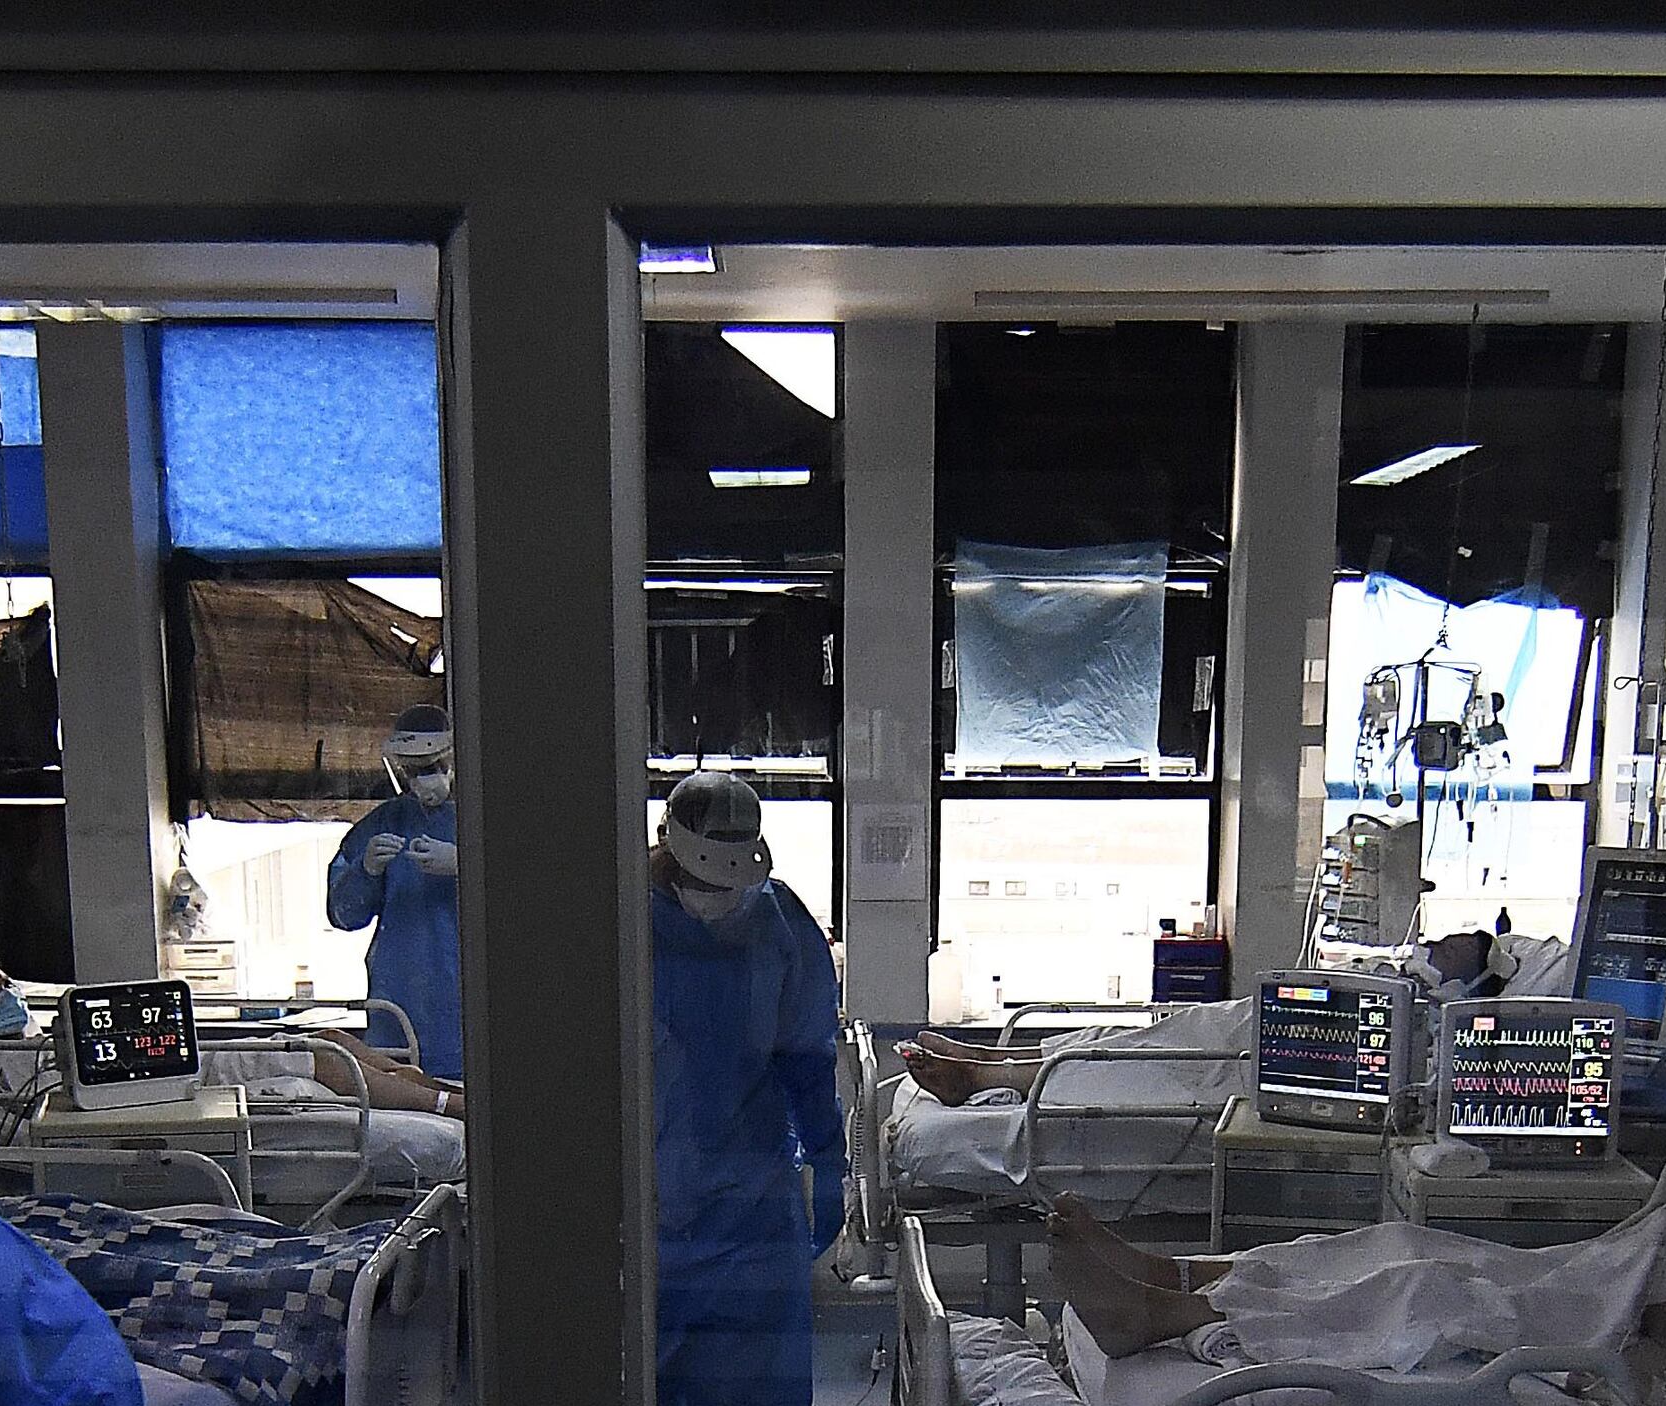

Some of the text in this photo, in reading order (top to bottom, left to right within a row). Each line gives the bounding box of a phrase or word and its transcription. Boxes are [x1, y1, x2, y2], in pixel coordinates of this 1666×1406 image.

[91, 1007, 161, 1030] 63 97
[1368, 1011, 1385, 1026] 96
[95, 1042, 118, 1062] 13
[134, 1036, 152, 1049] 123
[159, 1034, 176, 1046] 122
[1369, 1033, 1387, 1048] 97
[1575, 1037, 1594, 1049] 110
[1584, 1061, 1604, 1077] 95
